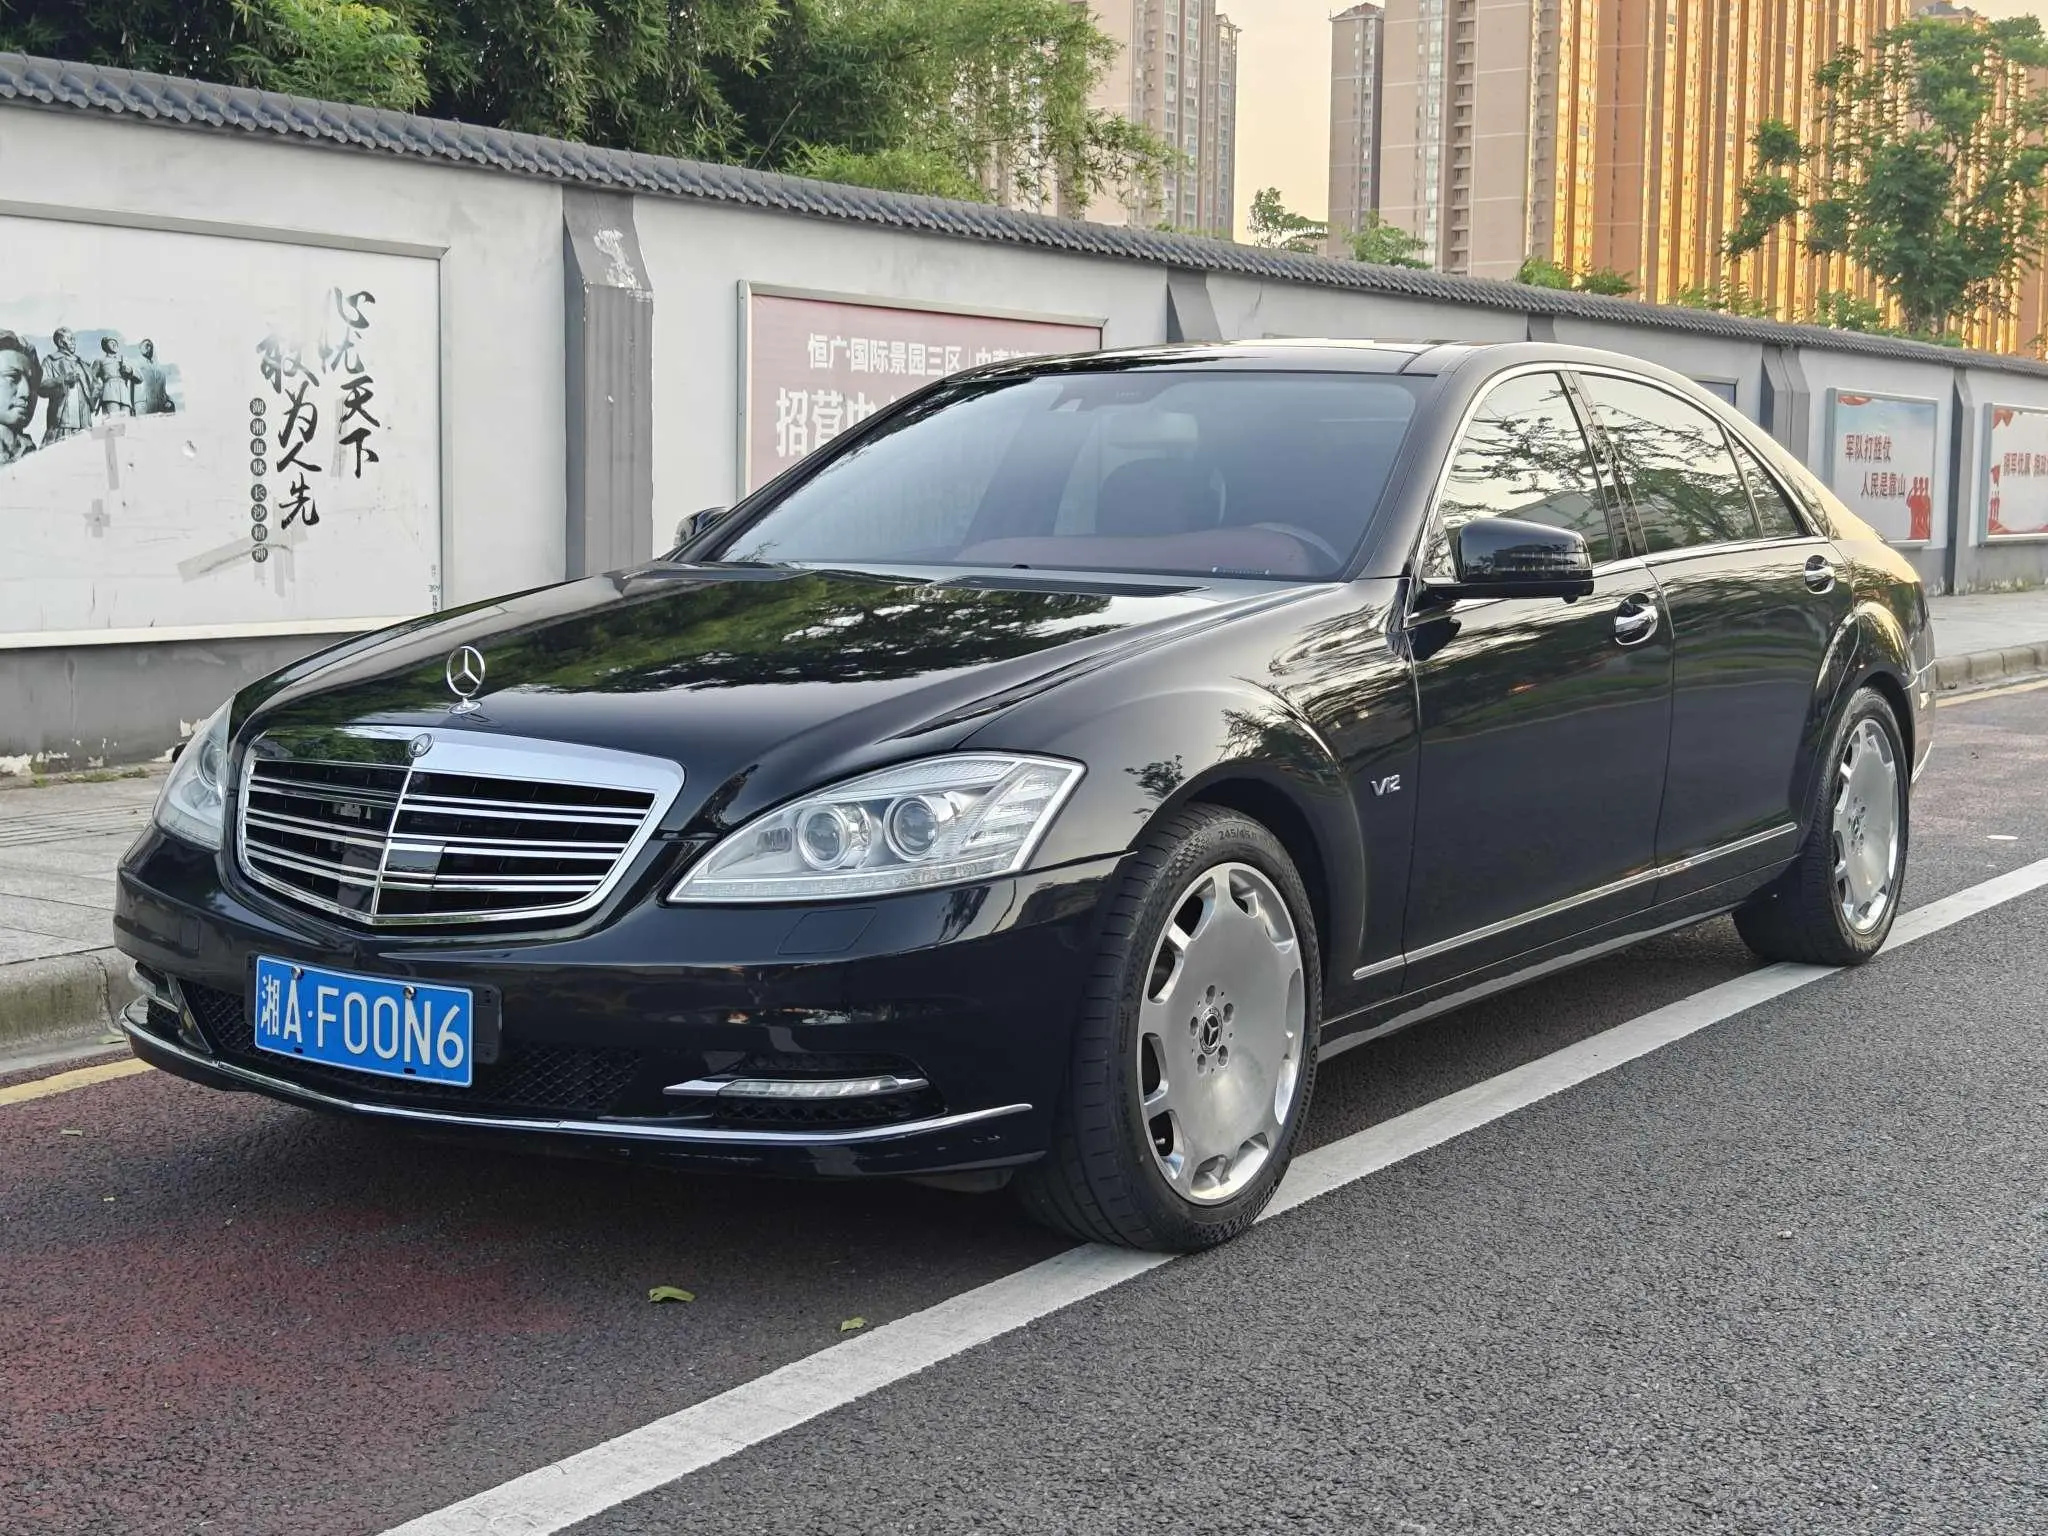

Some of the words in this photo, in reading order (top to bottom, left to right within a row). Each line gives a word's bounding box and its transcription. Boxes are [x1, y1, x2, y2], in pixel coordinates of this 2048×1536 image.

[256, 334, 323, 529] 敢为人先
[1845, 434, 1892, 463] 军队打胜仗
[1860, 471, 1906, 498] 人民是靠山
[1370, 774, 1401, 796] V12
